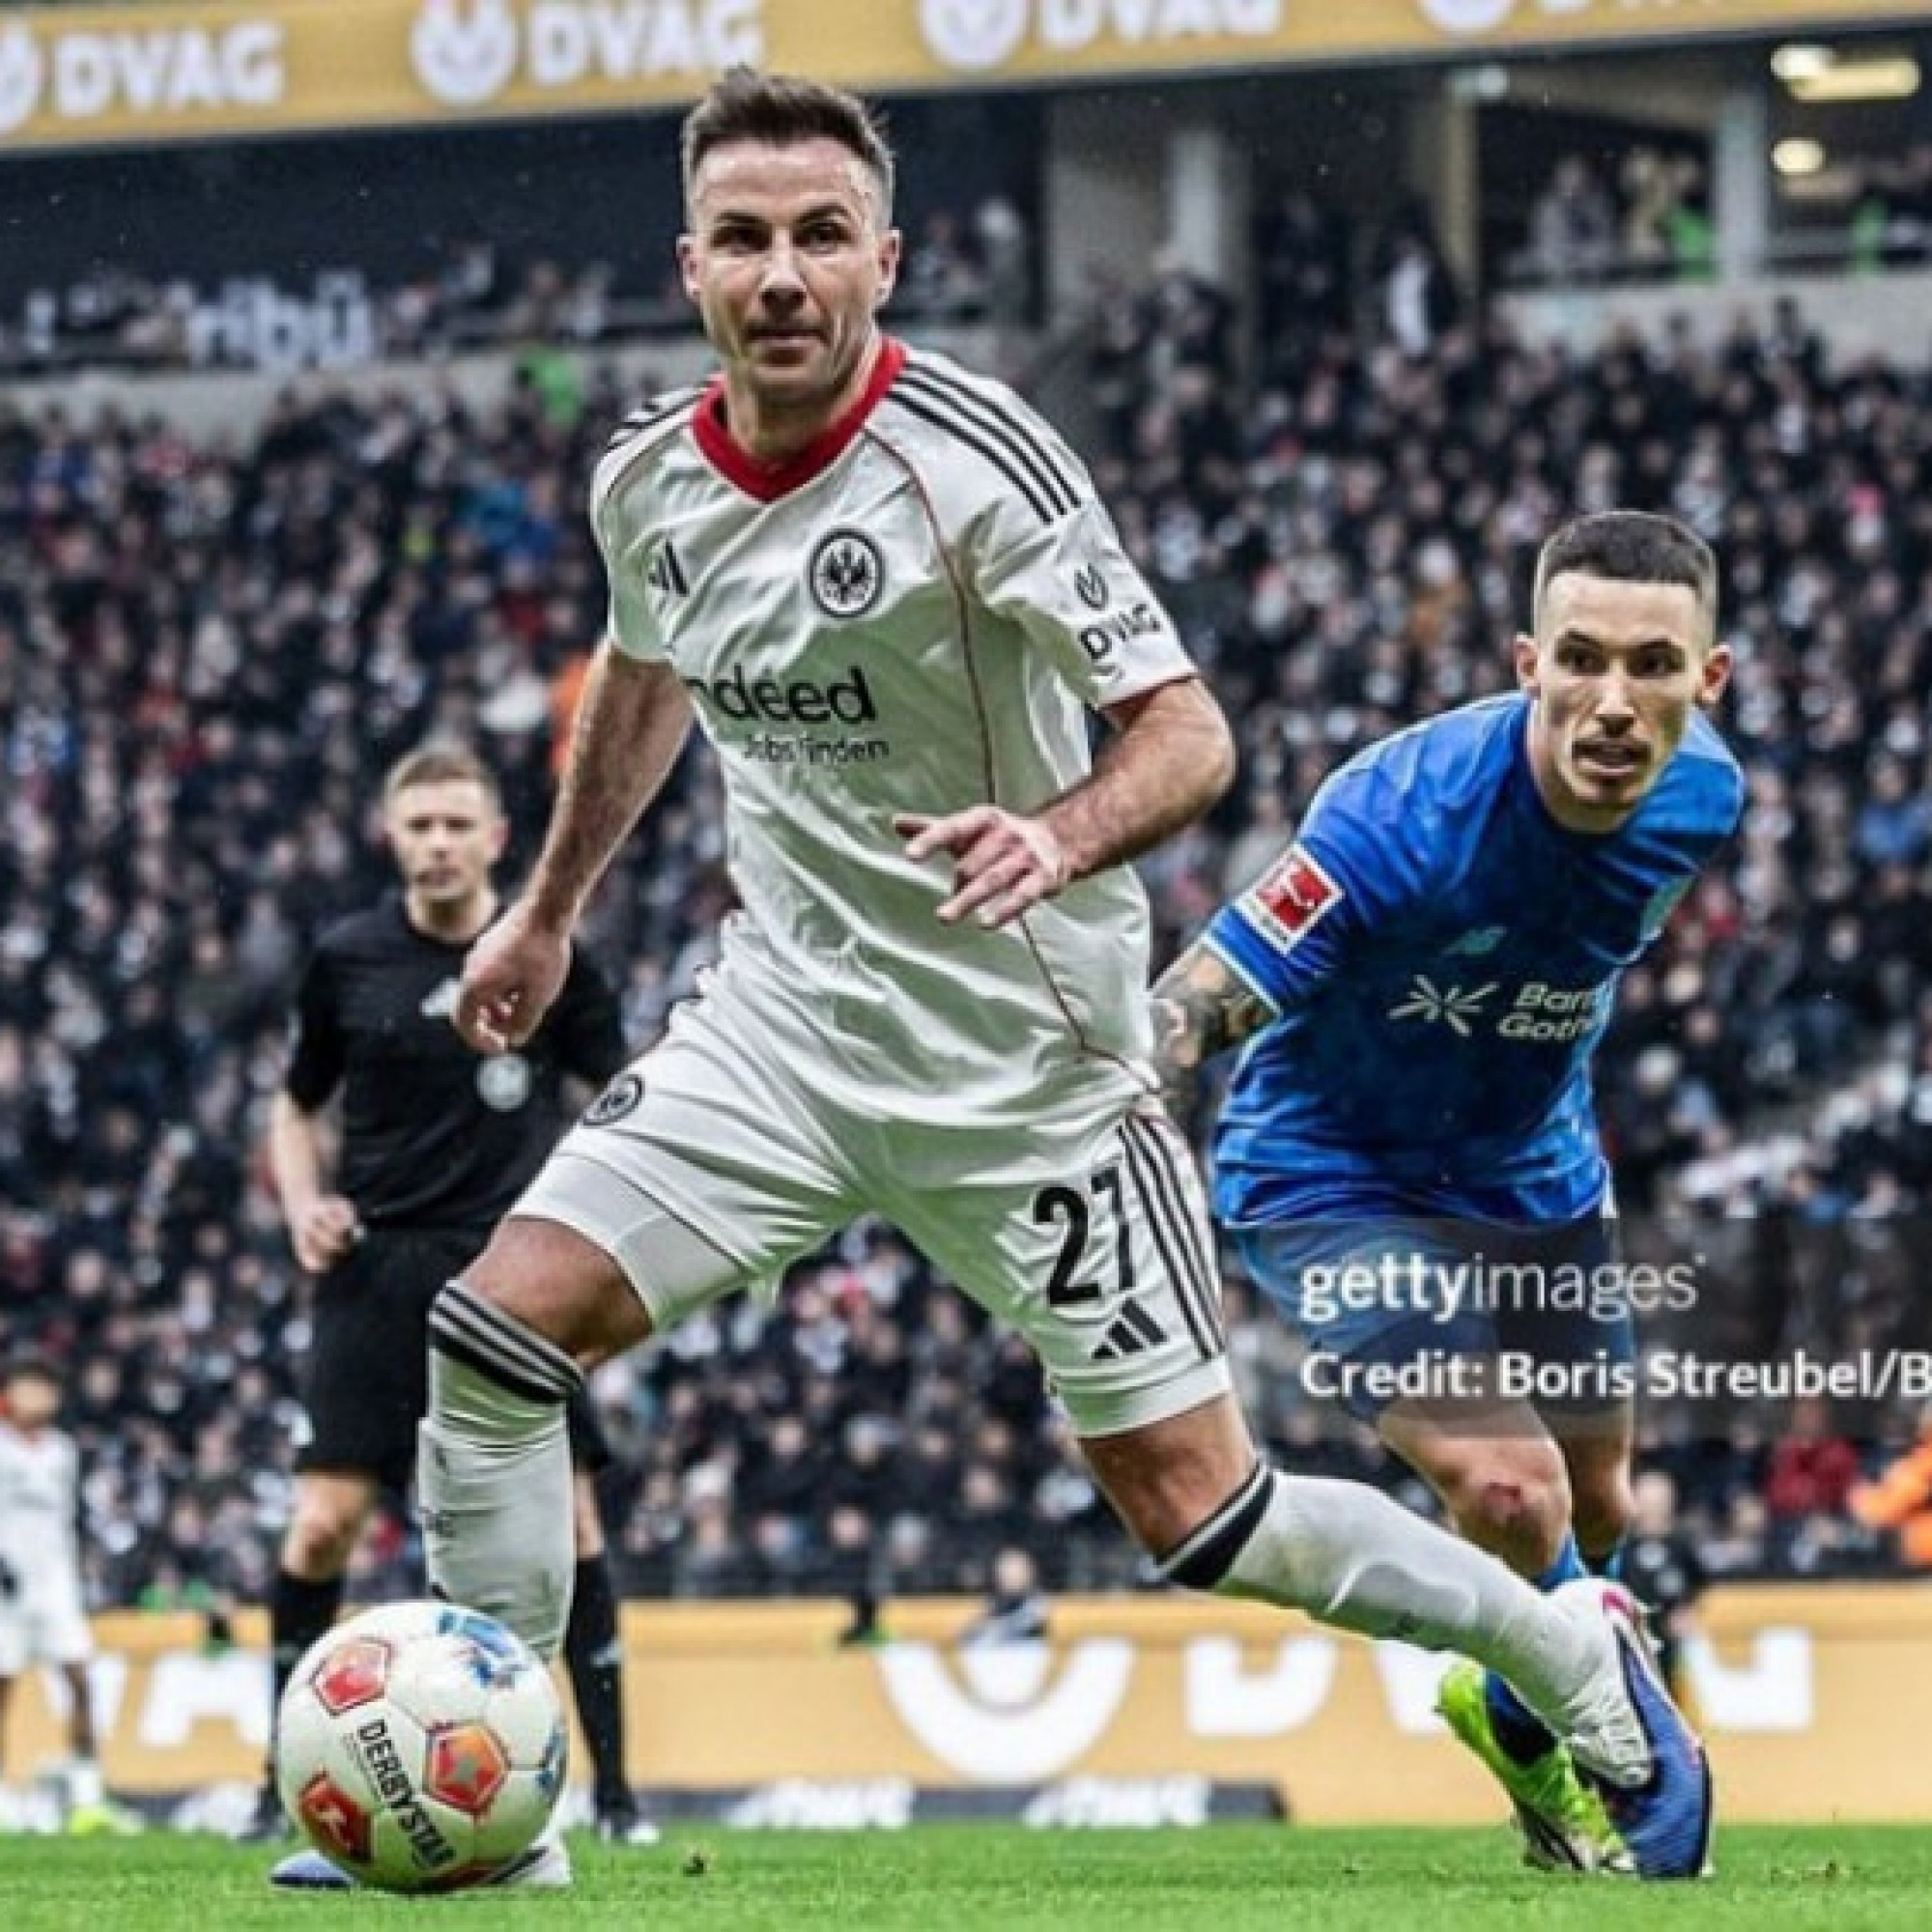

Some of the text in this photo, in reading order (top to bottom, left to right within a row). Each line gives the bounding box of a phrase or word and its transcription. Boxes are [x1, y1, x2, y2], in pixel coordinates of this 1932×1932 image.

[52, 21, 287, 118] DVAG
[528, 0, 766, 85] DVAG
[1034, 1166, 1135, 1307] 27
